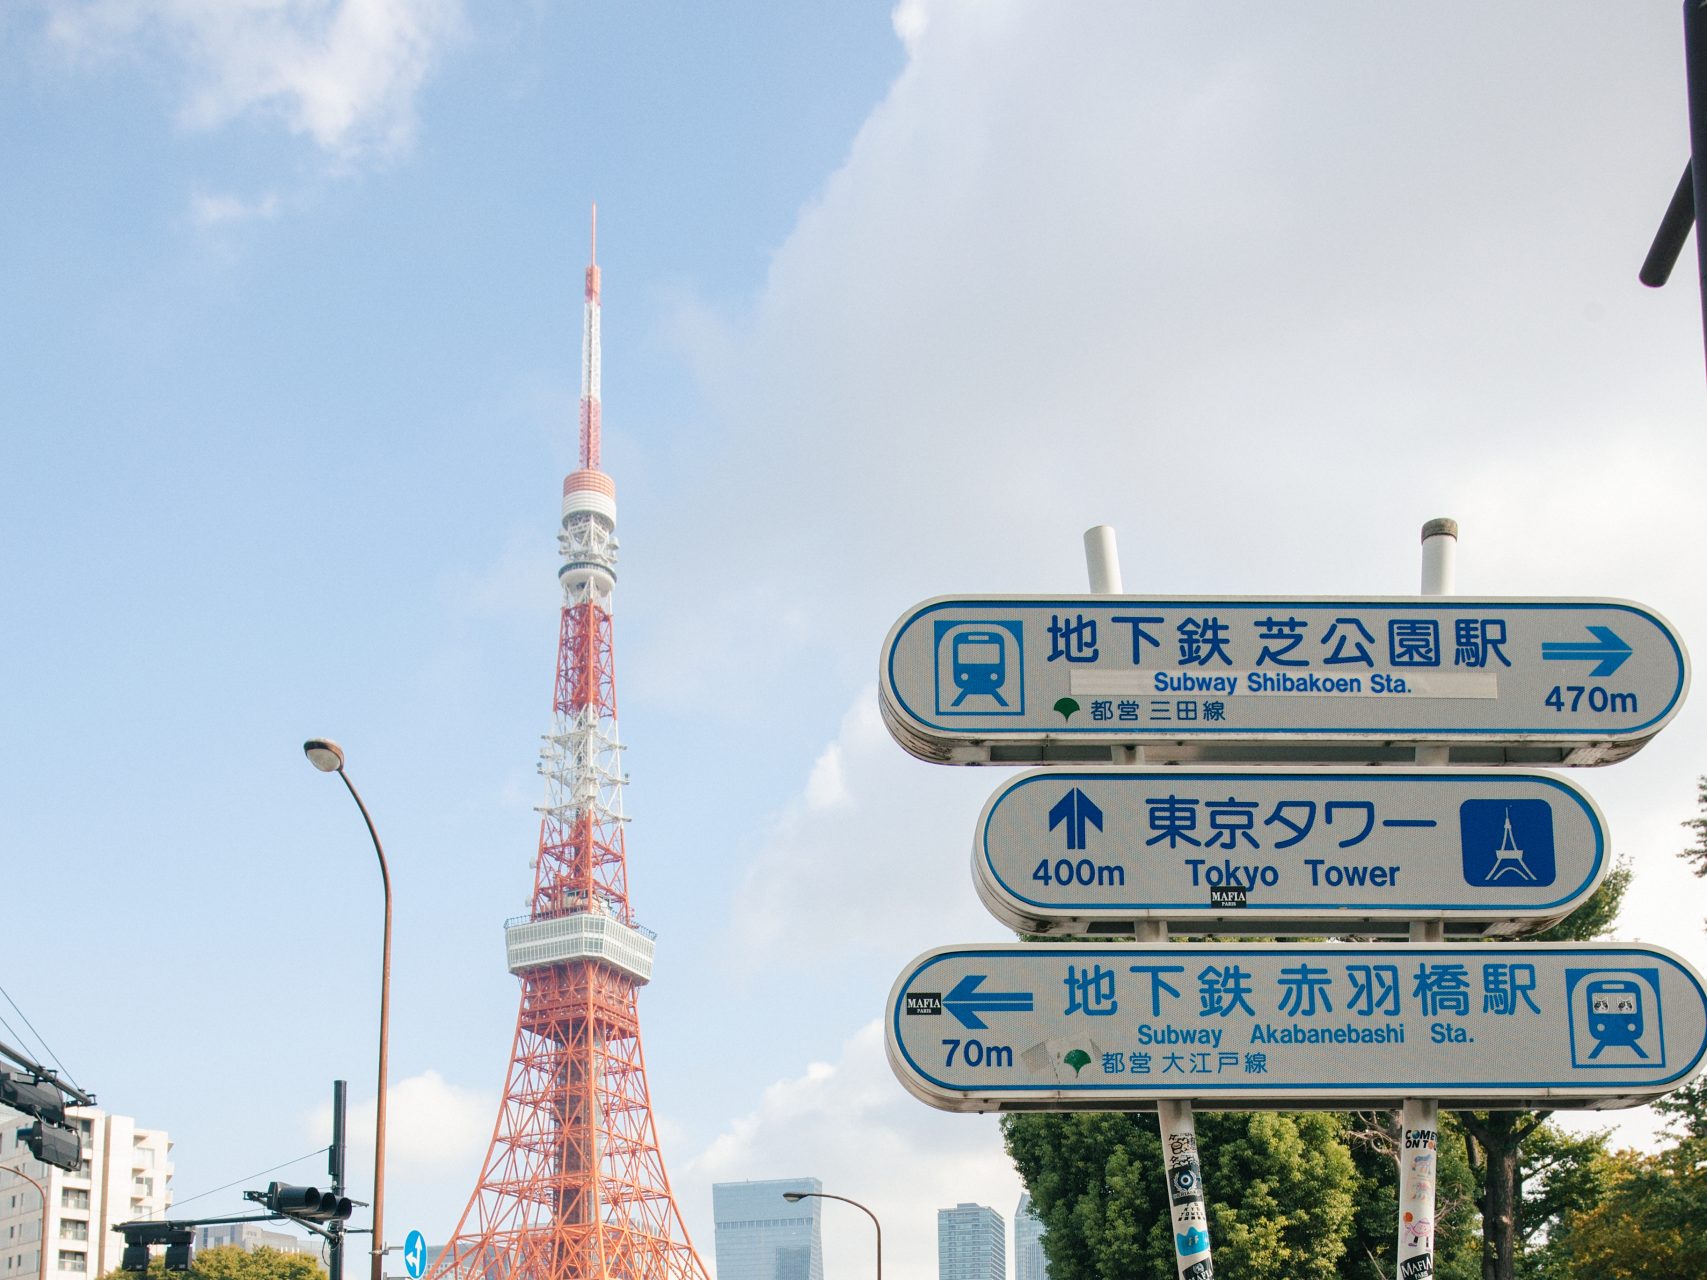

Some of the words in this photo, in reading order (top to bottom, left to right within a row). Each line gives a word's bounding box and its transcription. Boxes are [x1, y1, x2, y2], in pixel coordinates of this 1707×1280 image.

[1046, 613, 1234, 667] 地下鉄
[1253, 615, 1513, 668] 芝公園駅
[1154, 671, 1238, 696] Subway
[1247, 671, 1362, 693] Shibakoen
[1370, 673, 1412, 694] Sta.
[1090, 700, 1140, 722] 都営
[1149, 700, 1227, 722] 三田線
[1544, 685, 1638, 713] 470m
[1145, 794, 1438, 850] 東京タワー
[1032, 858, 1125, 887] 400m
[1185, 859, 1279, 893] Tokyo
[1304, 859, 1401, 887] Tower
[1211, 891, 1246, 902] MAFIA
[907, 998, 942, 1009] MAFIA
[1063, 964, 1256, 1018] 地下鉄
[1277, 962, 1542, 1018] 赤羽橋駅
[1137, 1024, 1223, 1049] Subway
[1249, 1022, 1405, 1044] Akabanebashi
[1430, 1022, 1475, 1044] Sta.
[941, 1038, 1013, 1068] 70m
[1101, 1051, 1151, 1075] 都営
[1161, 1051, 1268, 1075] 大江戸線
[1405, 1139, 1420, 1149] ON
[1401, 1256, 1433, 1279] MAFIA
